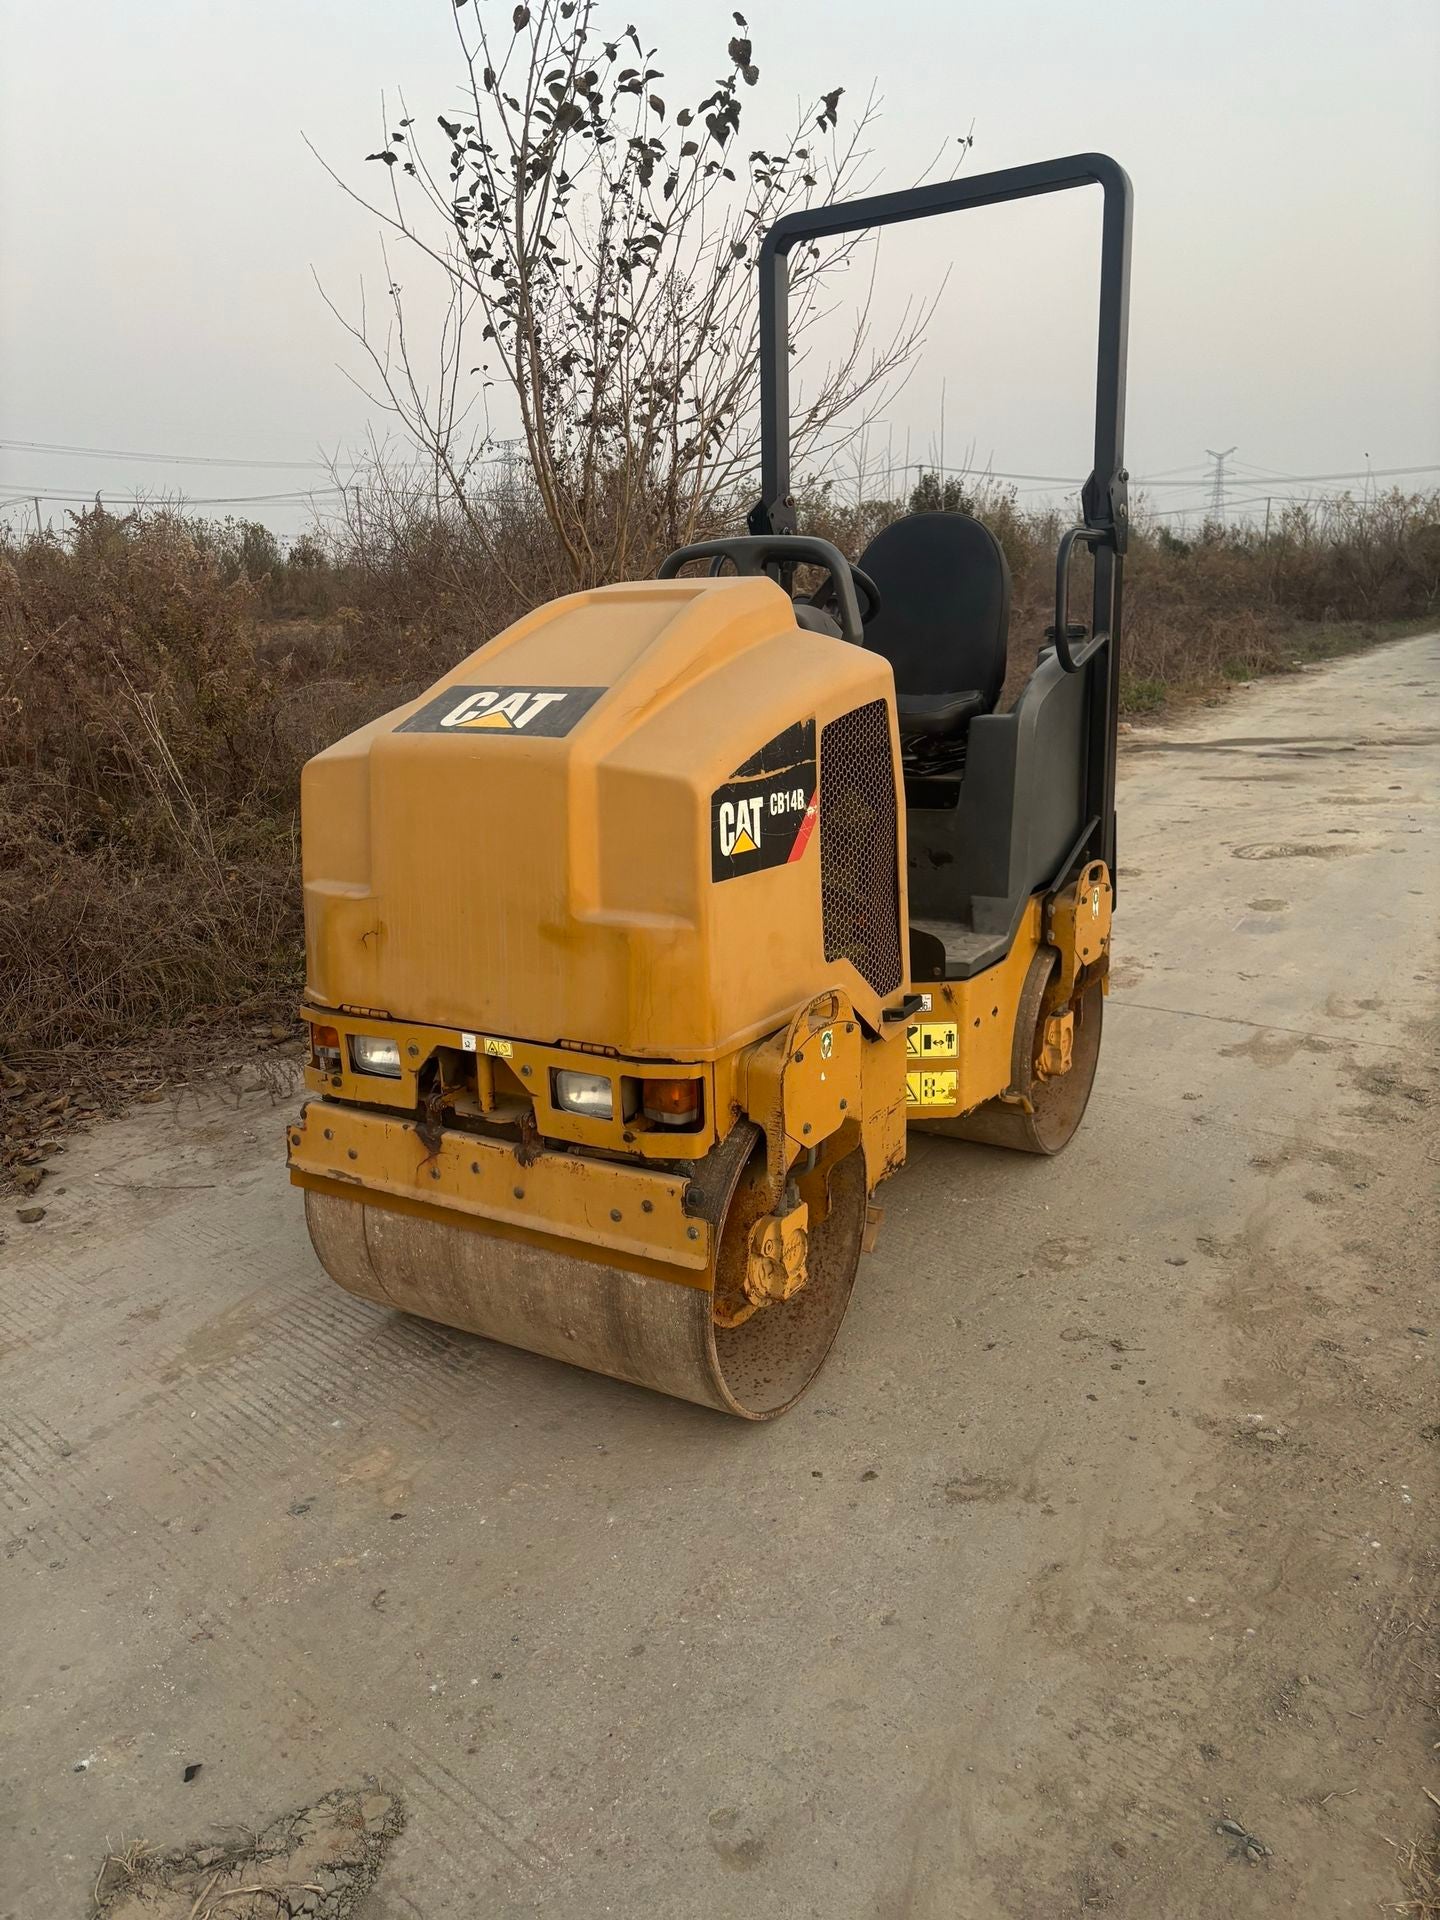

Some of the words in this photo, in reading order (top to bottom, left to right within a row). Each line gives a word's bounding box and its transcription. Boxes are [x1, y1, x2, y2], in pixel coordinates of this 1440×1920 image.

[440, 691, 568, 728] CAT
[719, 797, 763, 856] CAT
[770, 788, 805, 816] CB14B
